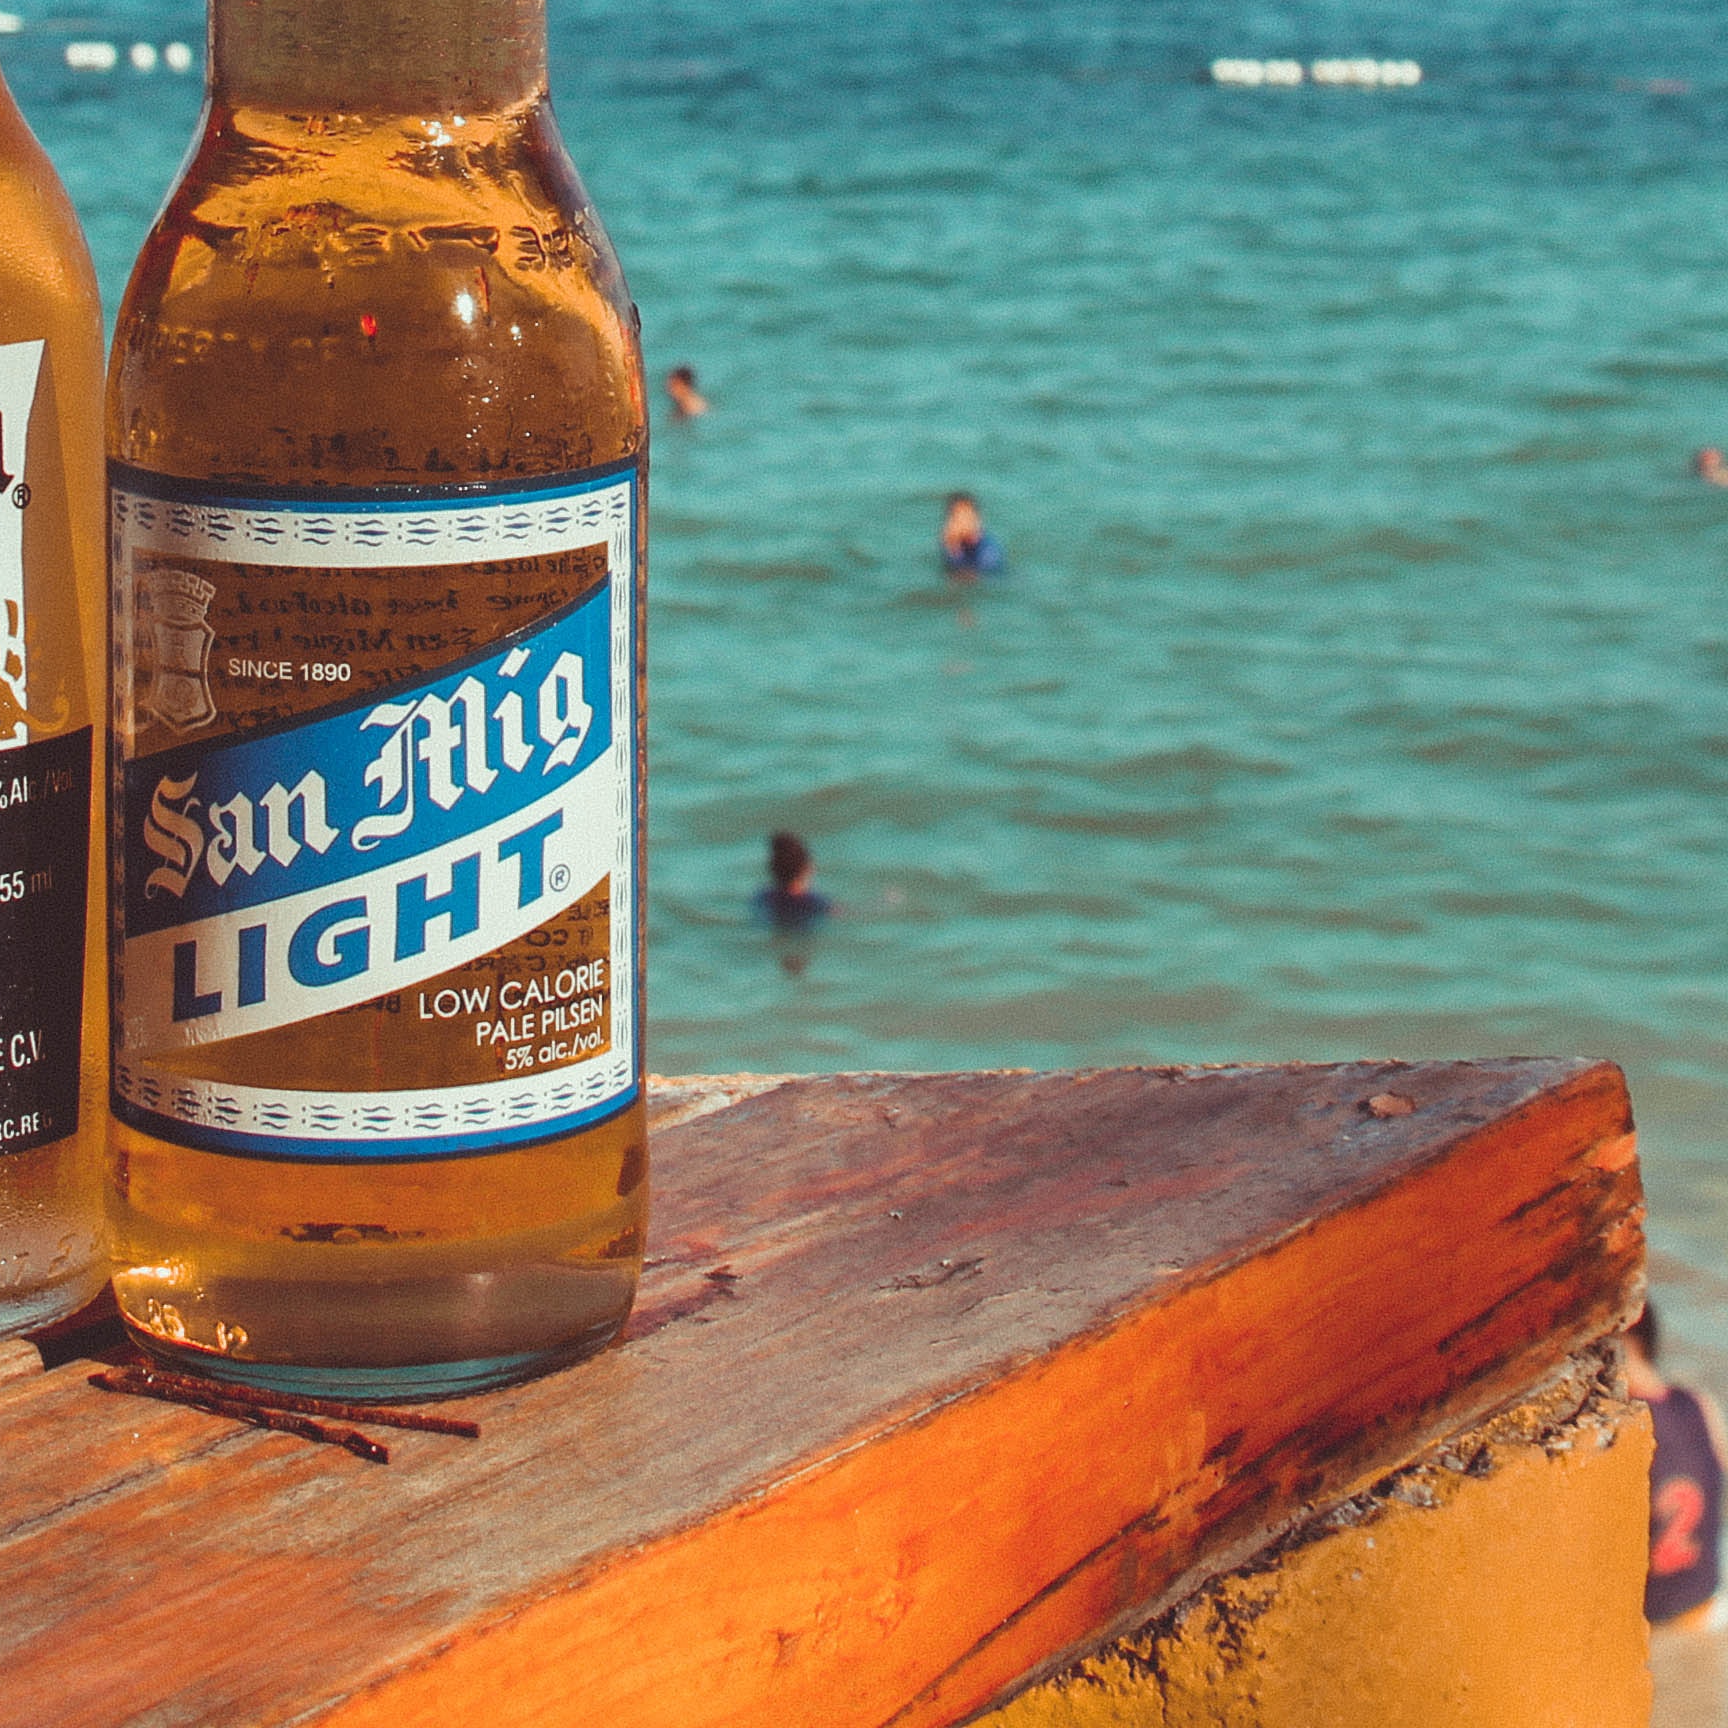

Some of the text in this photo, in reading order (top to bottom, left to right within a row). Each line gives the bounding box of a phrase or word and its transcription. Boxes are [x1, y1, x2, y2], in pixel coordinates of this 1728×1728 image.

[228, 658, 293, 681] SINCE
[300, 662, 352, 683] 1890
[144, 647, 593, 900] San Mig
[173, 808, 564, 1023] LIGHT
[419, 985, 491, 1020] LOW
[499, 958, 605, 1010] CALORIE
[476, 994, 604, 1047] PALE PILSEN
[504, 1029, 605, 1070] 5% alc./vol.
[1651, 1476, 1705, 1576] 2
